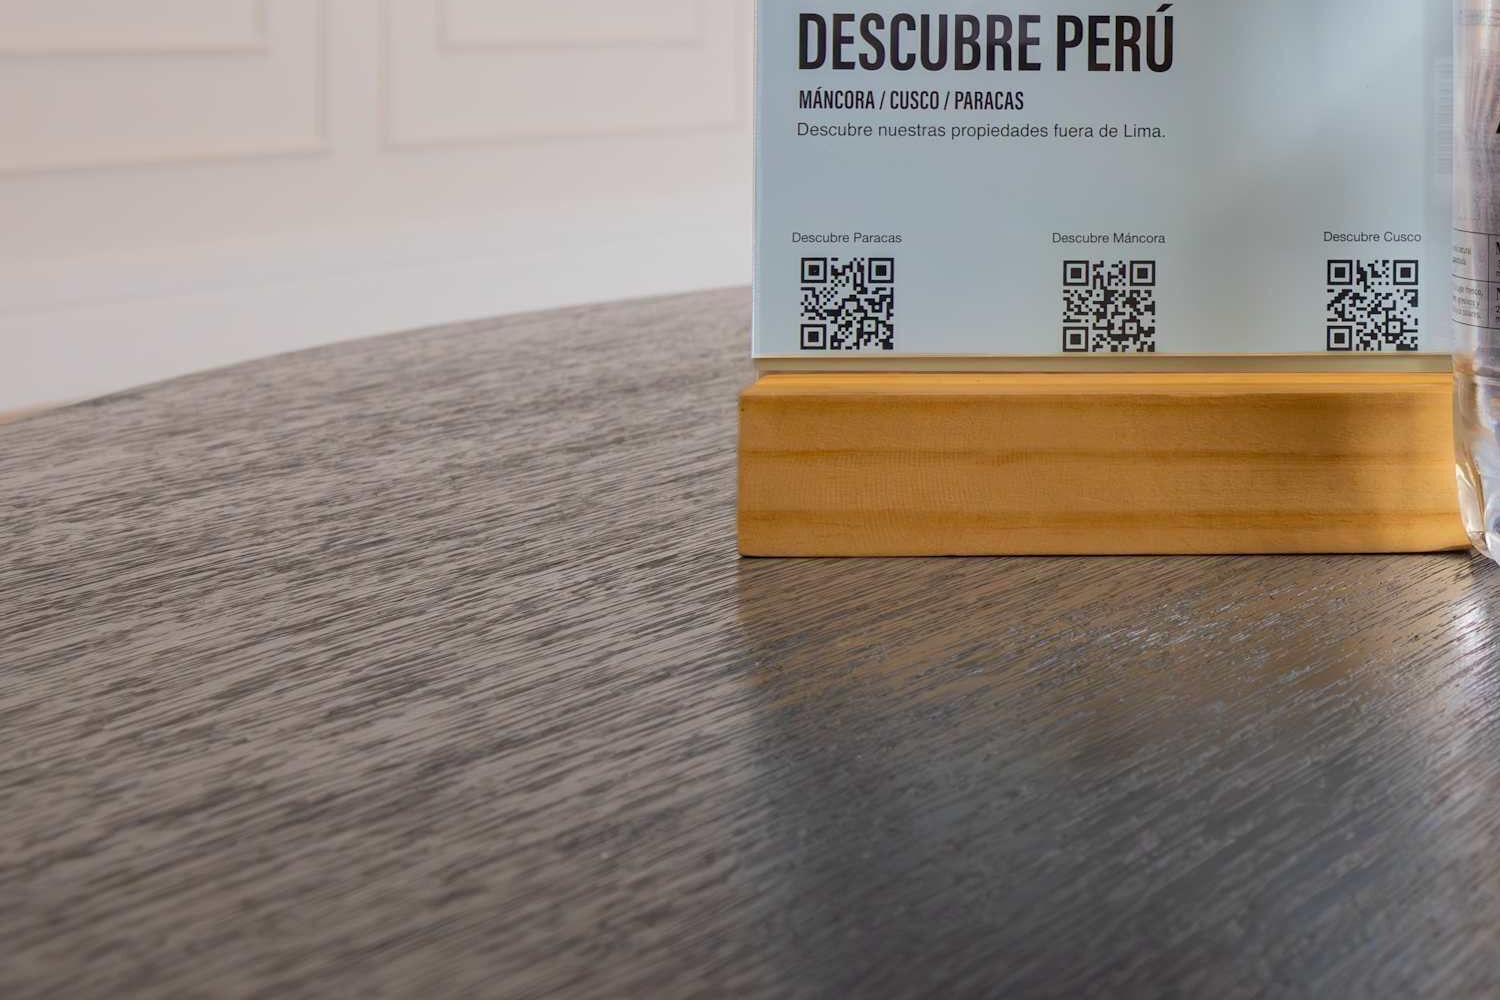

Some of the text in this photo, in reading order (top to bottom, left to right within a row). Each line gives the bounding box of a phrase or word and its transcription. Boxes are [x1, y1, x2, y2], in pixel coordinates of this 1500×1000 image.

[798, 3, 1174, 73] DESCUBRE PERÚ
[799, 86, 1024, 110] MÁNCORA / CUSCO / PARACAS
[797, 122, 1166, 140] Descubre nuestras propiedades fuera de Lima.
[792, 231, 902, 243] Descubre Paracas
[1052, 232, 1166, 243] Descubre Máncora
[1323, 231, 1421, 242] Descubre Cusco
